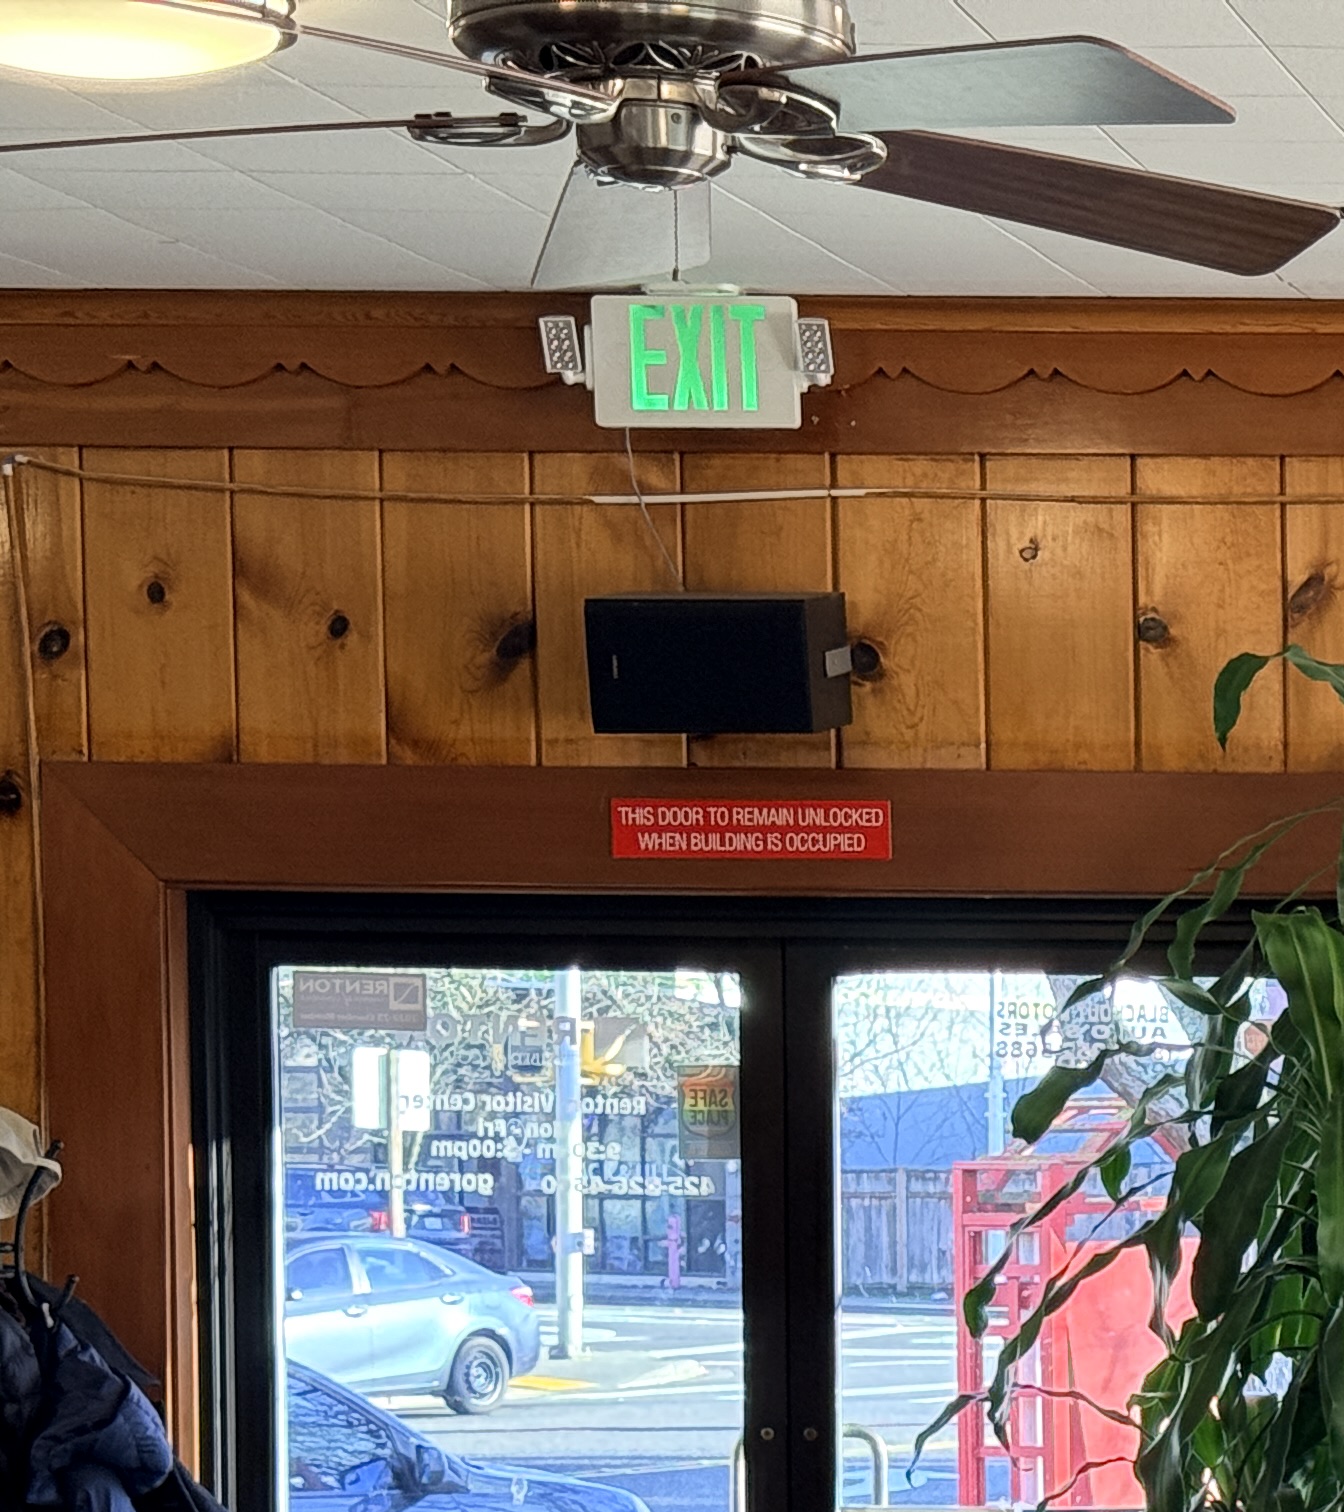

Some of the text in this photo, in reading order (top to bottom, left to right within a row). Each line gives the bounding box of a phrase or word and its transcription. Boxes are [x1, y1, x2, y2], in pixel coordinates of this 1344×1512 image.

[629, 304, 765, 411] EXIT
[618, 807, 884, 827] THIS DOOR TO REMAIN UNLOCKED
[638, 832, 866, 852] WHEN BUILDING IS OCCUPIED
